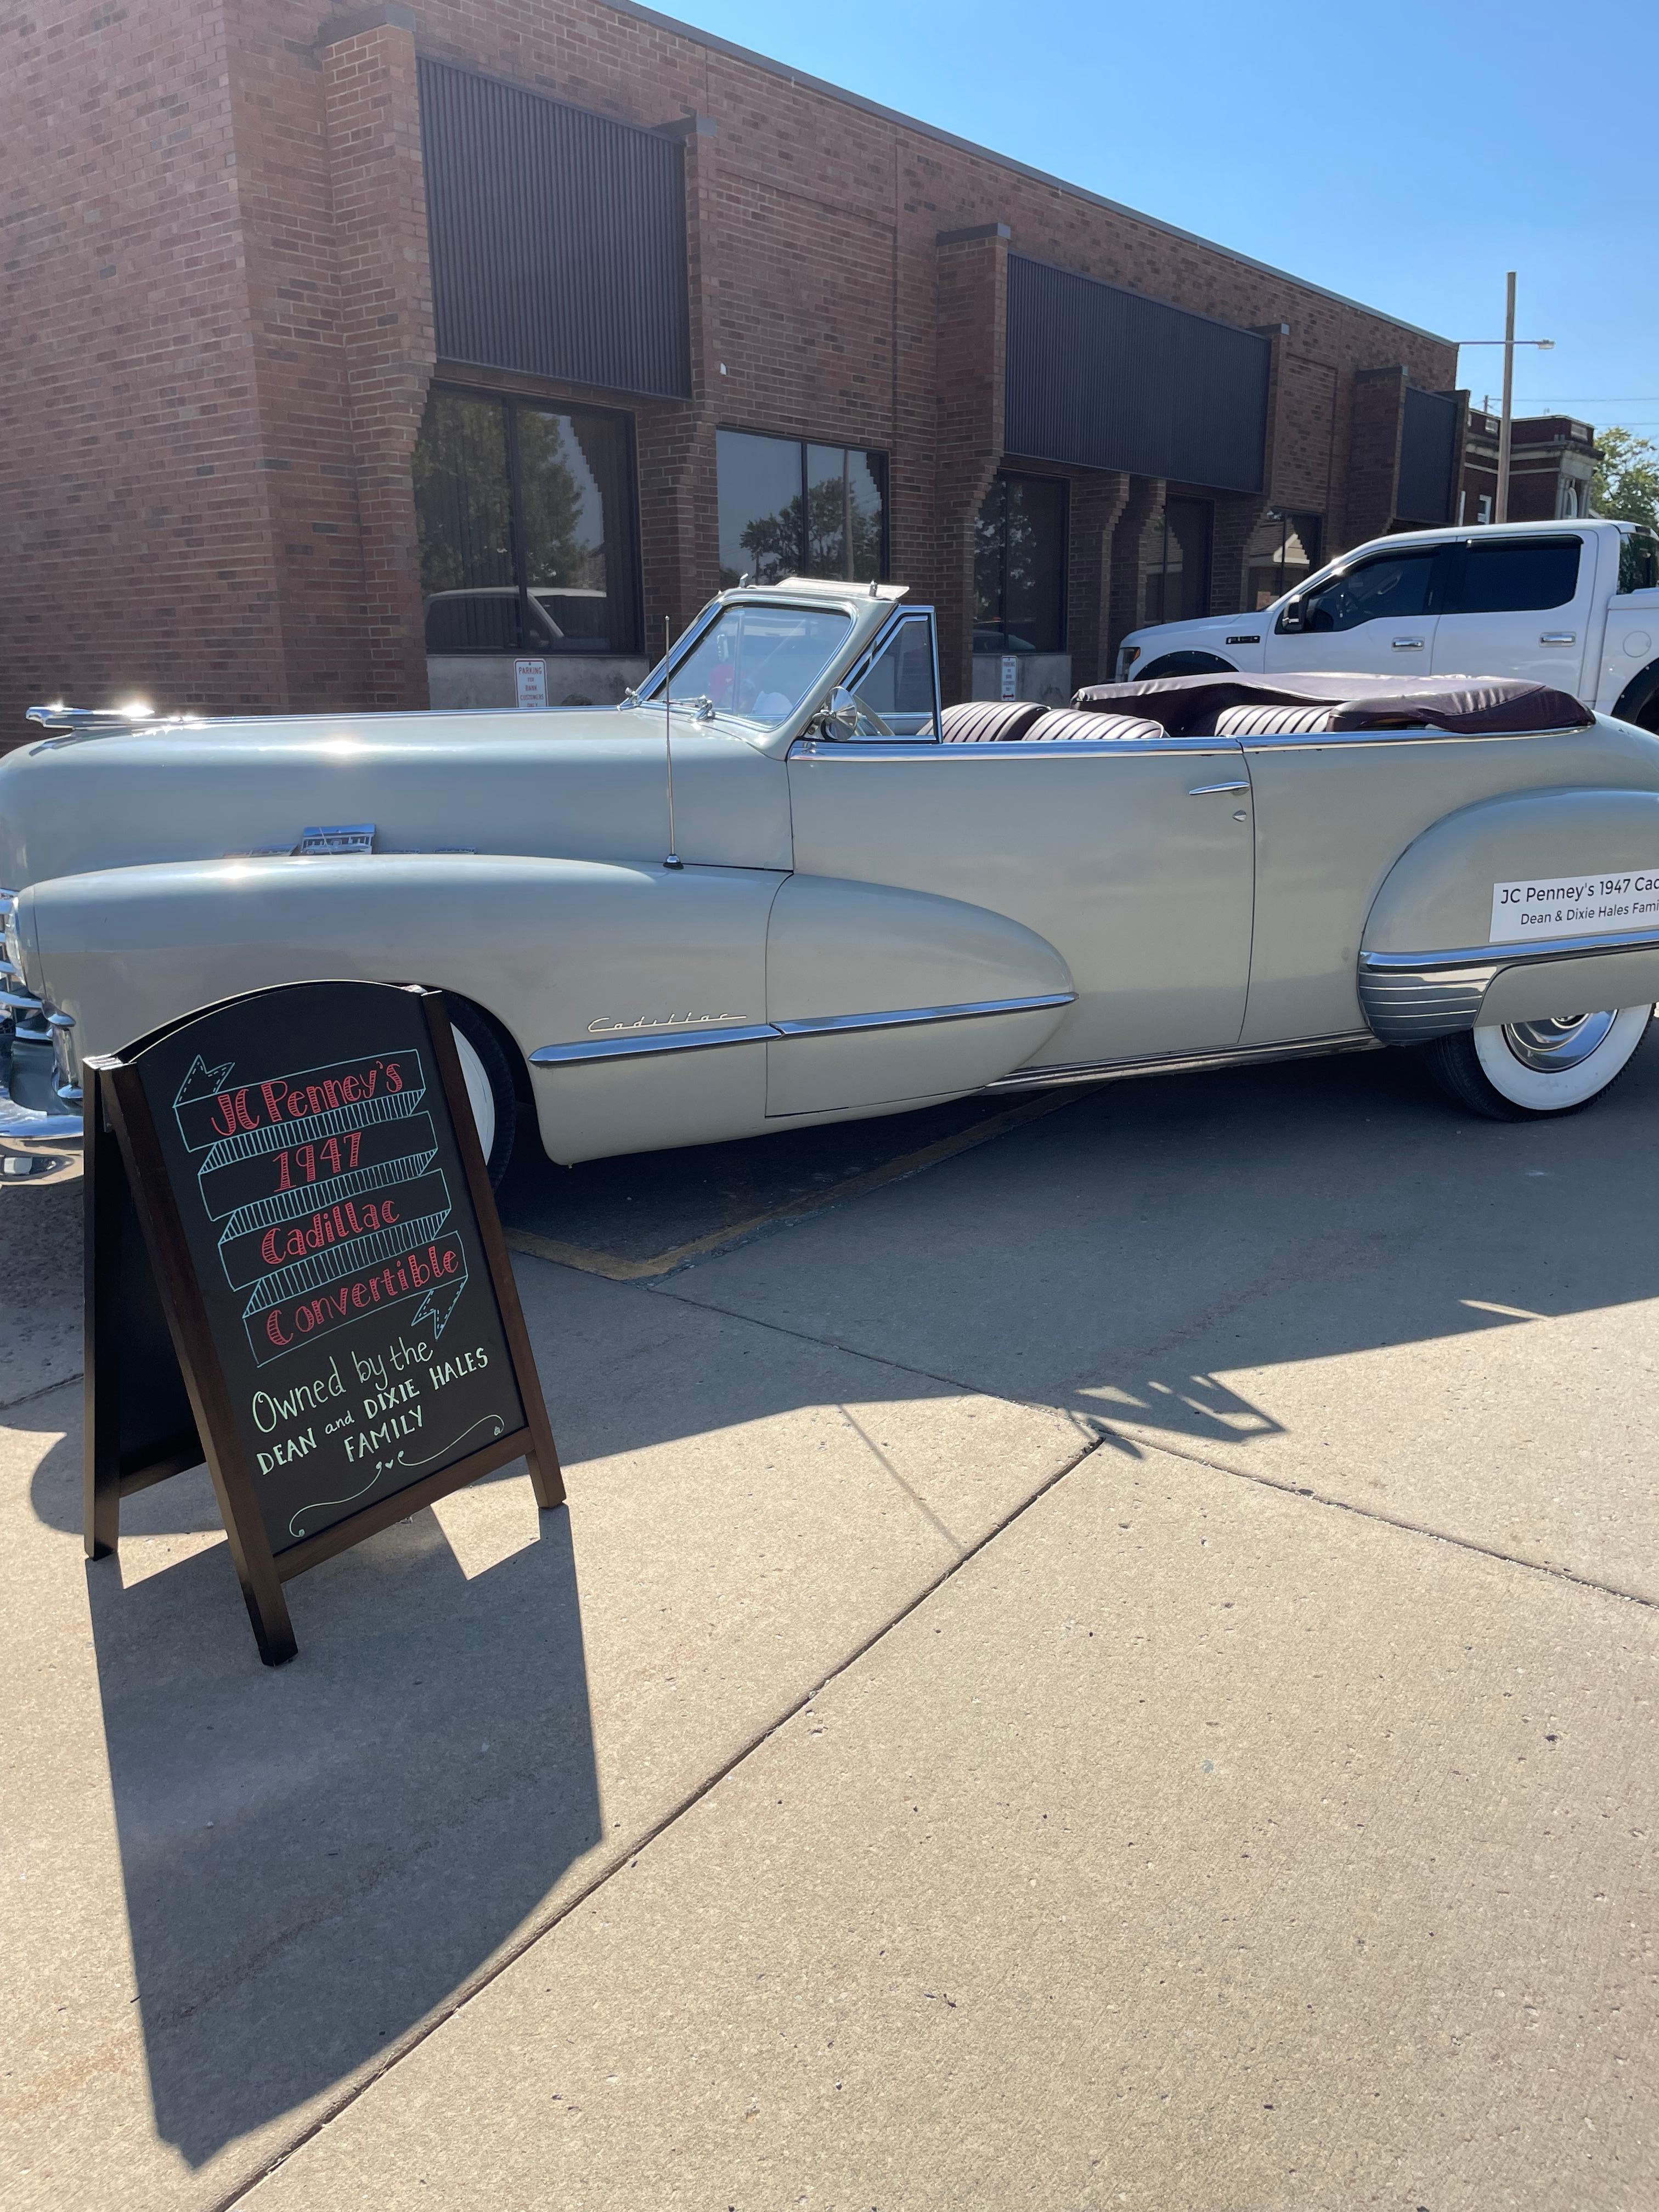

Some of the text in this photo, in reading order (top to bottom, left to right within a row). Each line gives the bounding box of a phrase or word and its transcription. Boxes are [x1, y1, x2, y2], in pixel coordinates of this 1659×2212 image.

[518, 667, 542, 675] PARKING
[1501, 889, 1520, 904] JC
[1527, 883, 1594, 902] Penney's
[1600, 879, 1630, 895] 1947
[1521, 914, 1550, 924] Dean
[1555, 911, 1562, 921] &
[1567, 907, 1594, 921] Dixie
[1599, 905, 1628, 917] Hales
[588, 1012, 746, 1032] Cadillac
[211, 1060, 403, 1136] JC Penney's
[273, 1132, 362, 1192] 1947
[261, 1200, 399, 1265] Cadillac
[267, 1246, 459, 1346] Convertible
[253, 1337, 433, 1432] Owned by the
[257, 1348, 488, 1475] DEAN and DIXIE HALES
[345, 1405, 422, 1462] FAMILY
